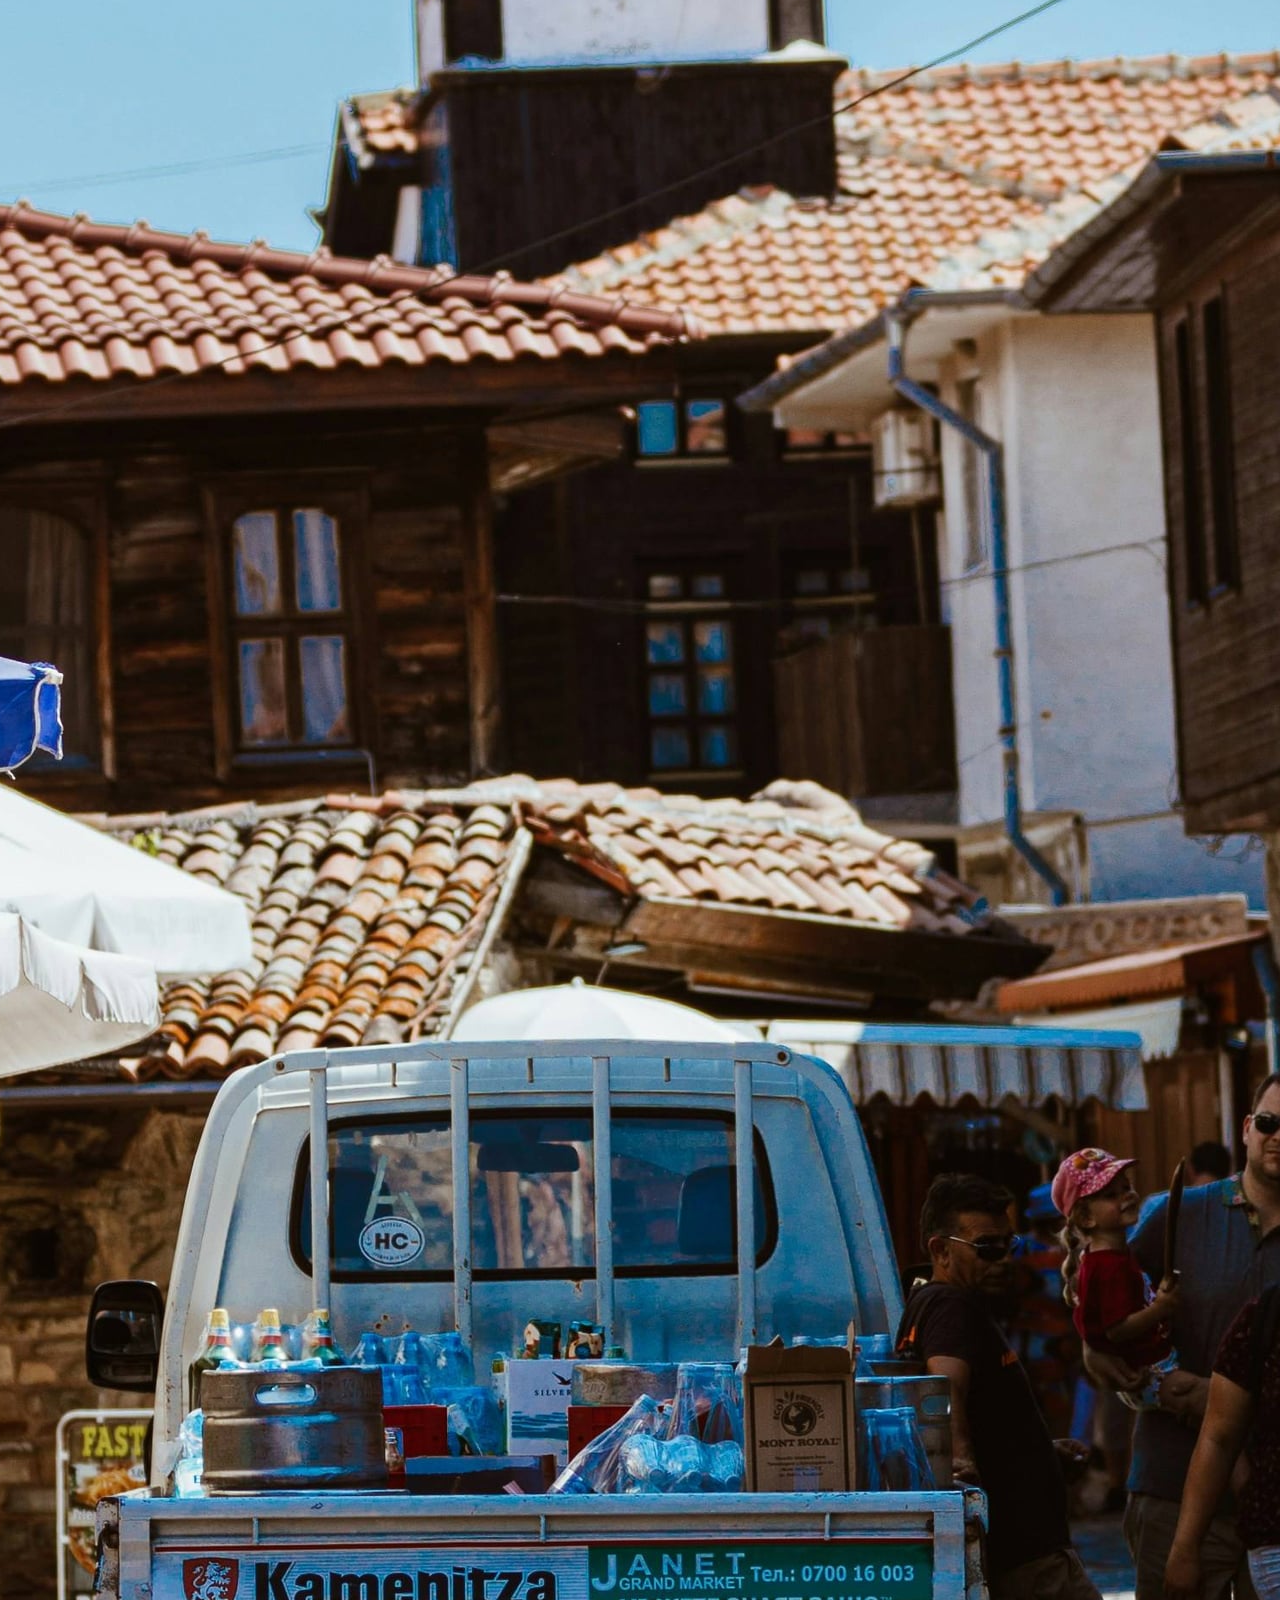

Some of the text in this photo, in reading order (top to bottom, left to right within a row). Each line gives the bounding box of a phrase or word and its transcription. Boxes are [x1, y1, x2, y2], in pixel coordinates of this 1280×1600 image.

[81, 1424, 147, 1458] FAST
[758, 1438, 795, 1448] MONT
[591, 1552, 745, 1591] JANET
[750, 1565, 915, 1583] Тел.: 0700 16 003
[619, 1576, 745, 1591] GRAND MARKET
